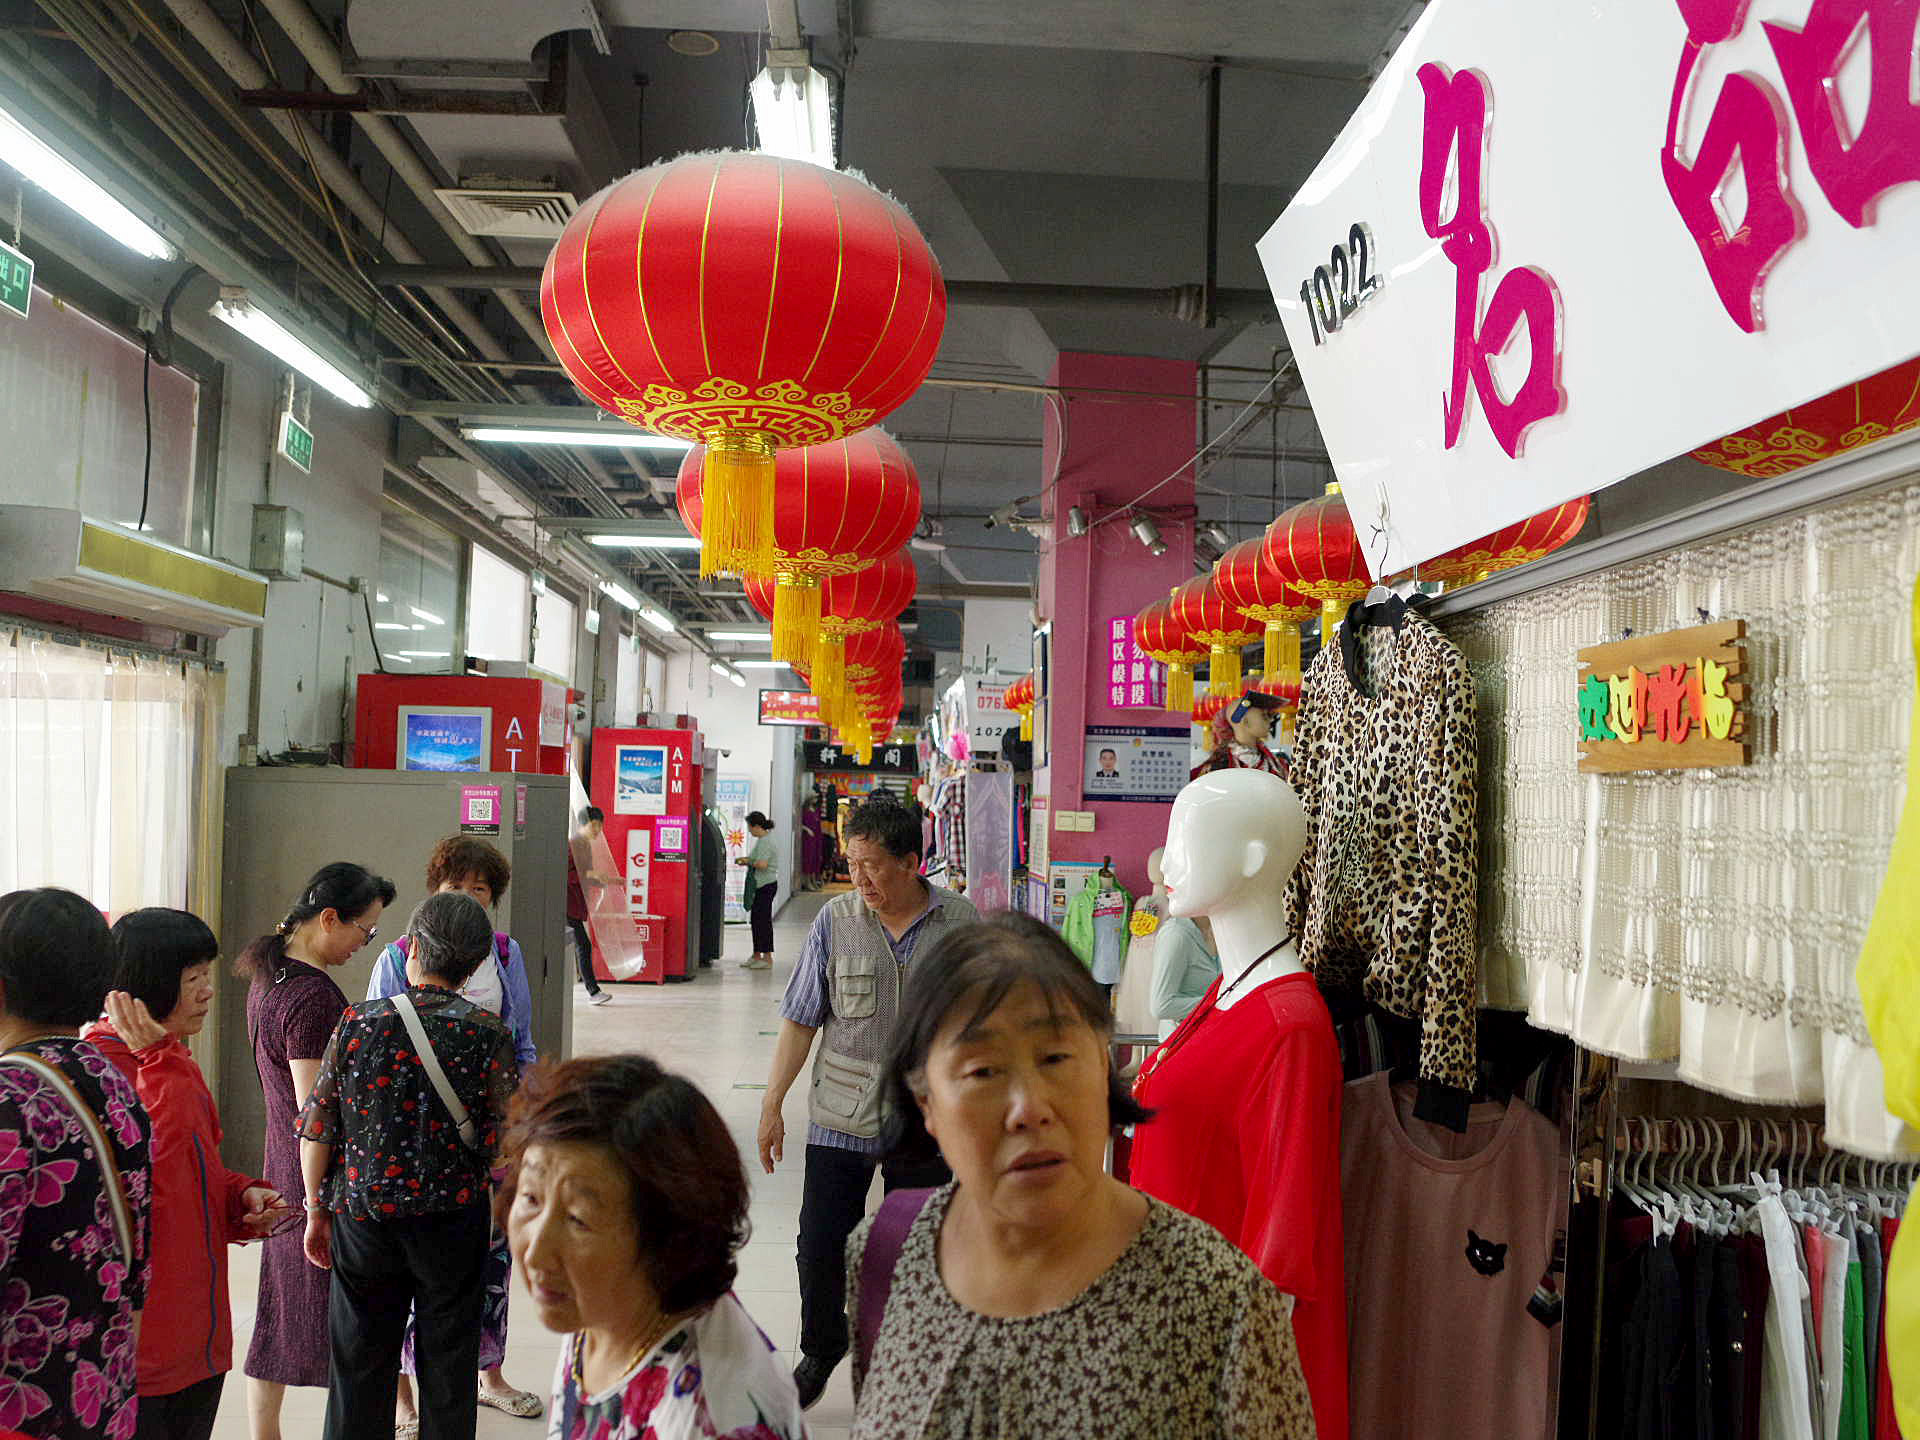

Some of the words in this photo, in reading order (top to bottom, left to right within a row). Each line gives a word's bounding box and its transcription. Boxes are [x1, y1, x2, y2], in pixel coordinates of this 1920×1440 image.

[1300, 222, 1378, 346] 1022
[976, 695, 1008, 710] 076
[1112, 619, 1126, 706] 展区模特
[1131, 617, 1145, 705] 勿触摸
[1578, 656, 1735, 744] 欢迎光临
[671, 747, 683, 793] ATM
